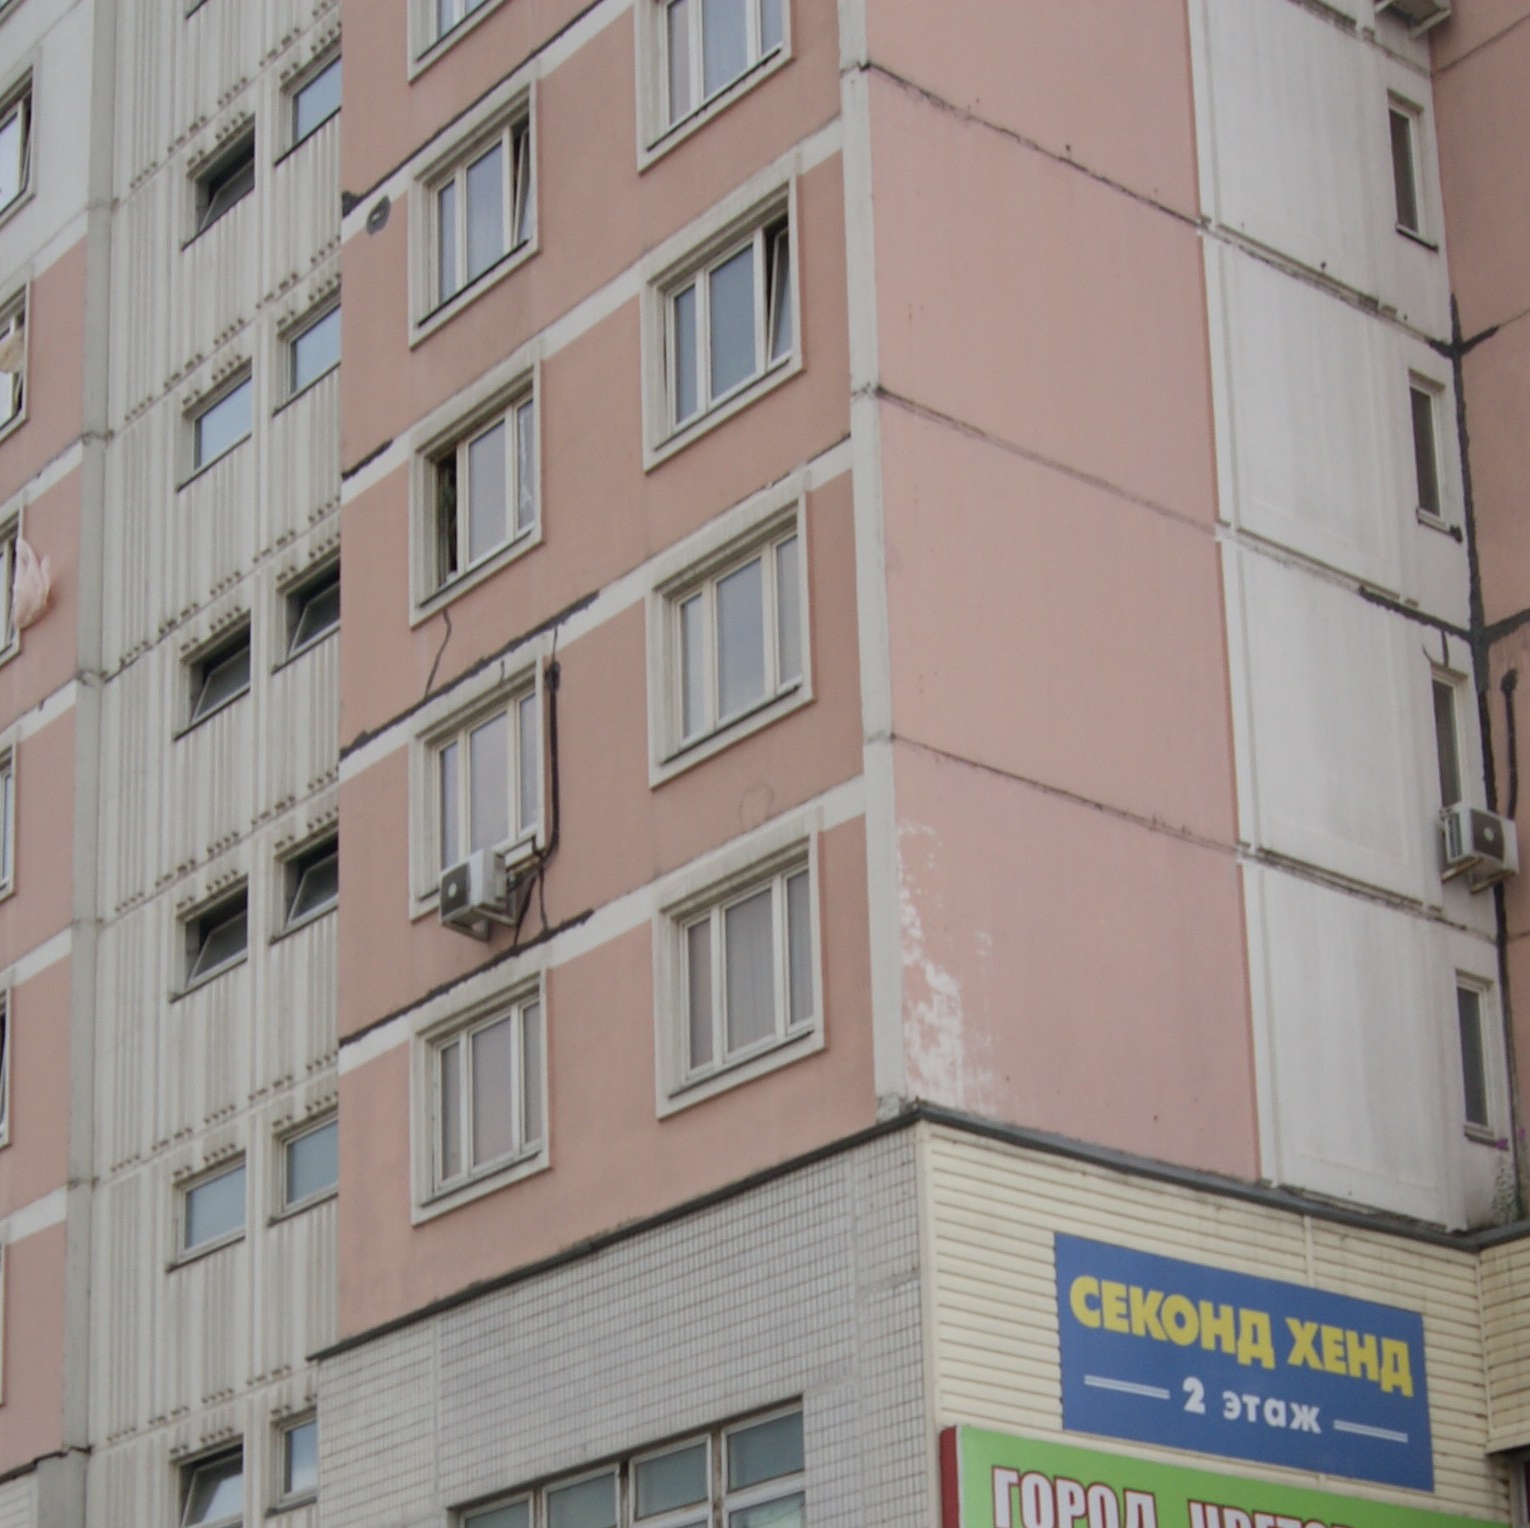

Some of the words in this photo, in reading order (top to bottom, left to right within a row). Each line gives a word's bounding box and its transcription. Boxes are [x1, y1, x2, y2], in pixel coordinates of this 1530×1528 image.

[1069, 1276, 1275, 1369] СЕКОНД
[1286, 1317, 1413, 1396] ХЕНД
[1183, 1378, 1205, 1413] 2
[1223, 1391, 1320, 1433] этаж
